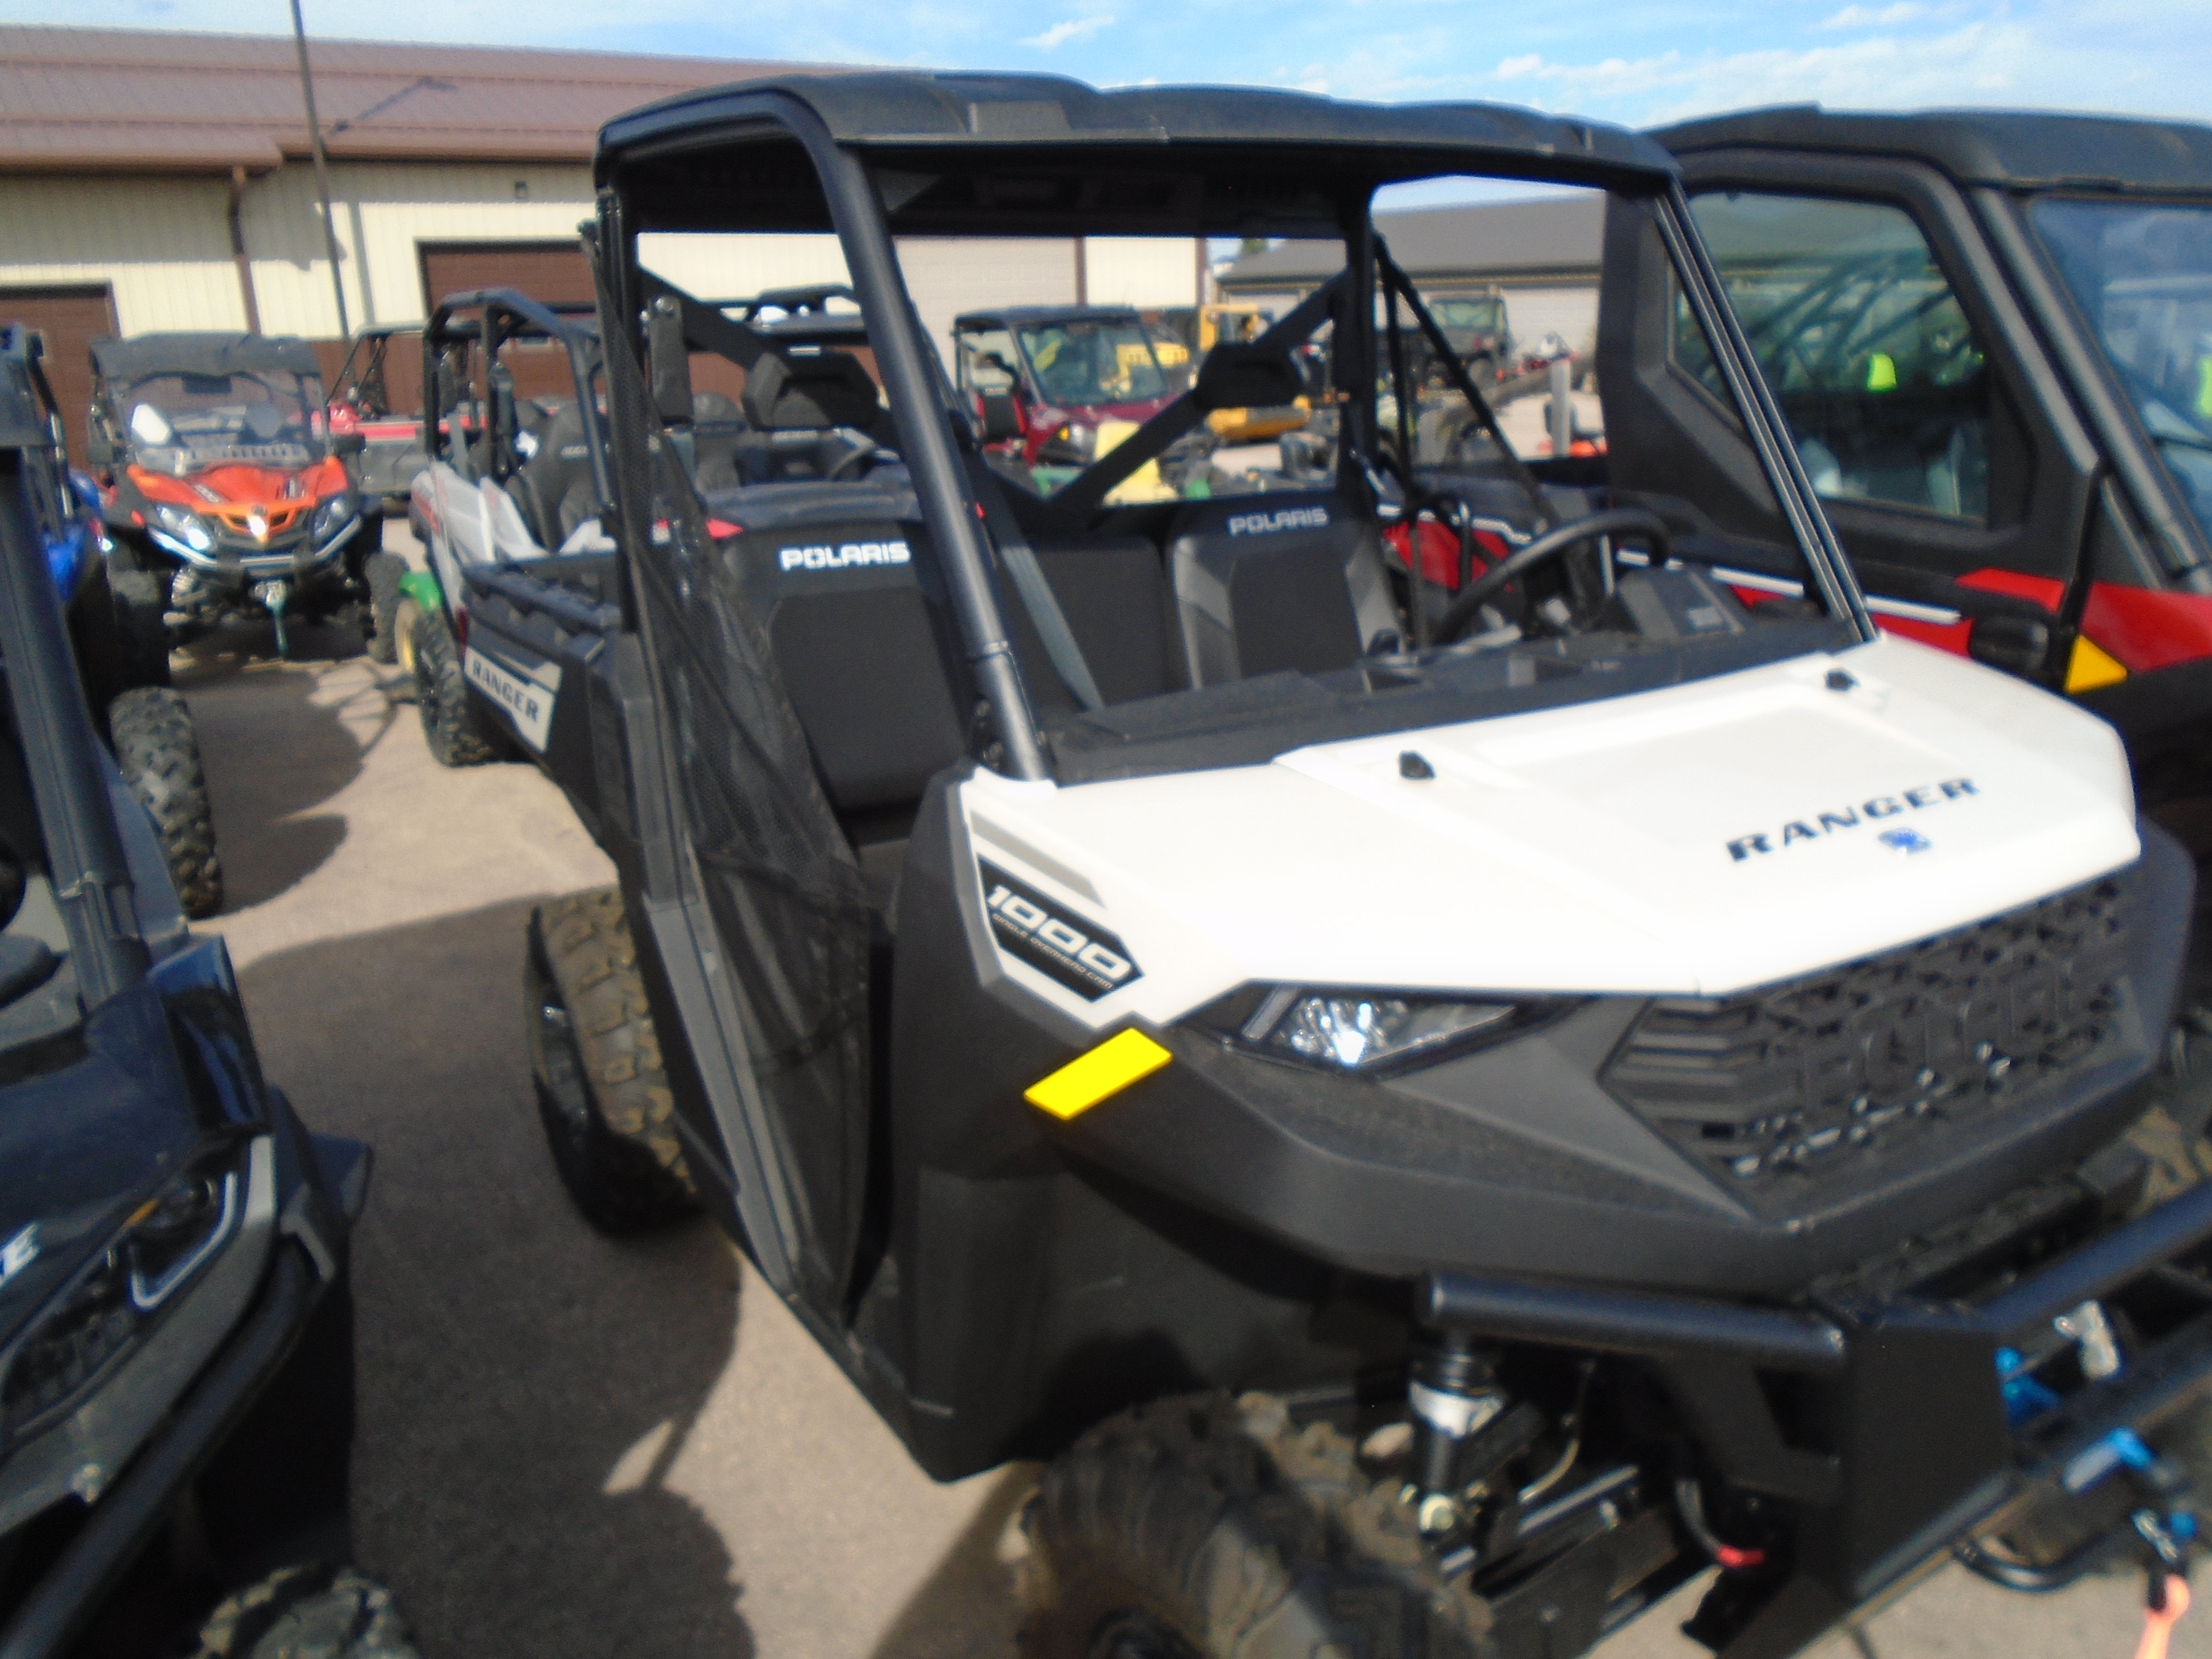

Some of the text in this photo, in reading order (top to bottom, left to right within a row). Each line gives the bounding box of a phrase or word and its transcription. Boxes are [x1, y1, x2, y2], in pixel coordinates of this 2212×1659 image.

[1230, 508, 1328, 536] POLARIS
[781, 542, 909, 571] POLARIS
[473, 659, 539, 723] RANGER
[1726, 778, 1980, 862] RANGER
[988, 886, 1130, 979] 1000
